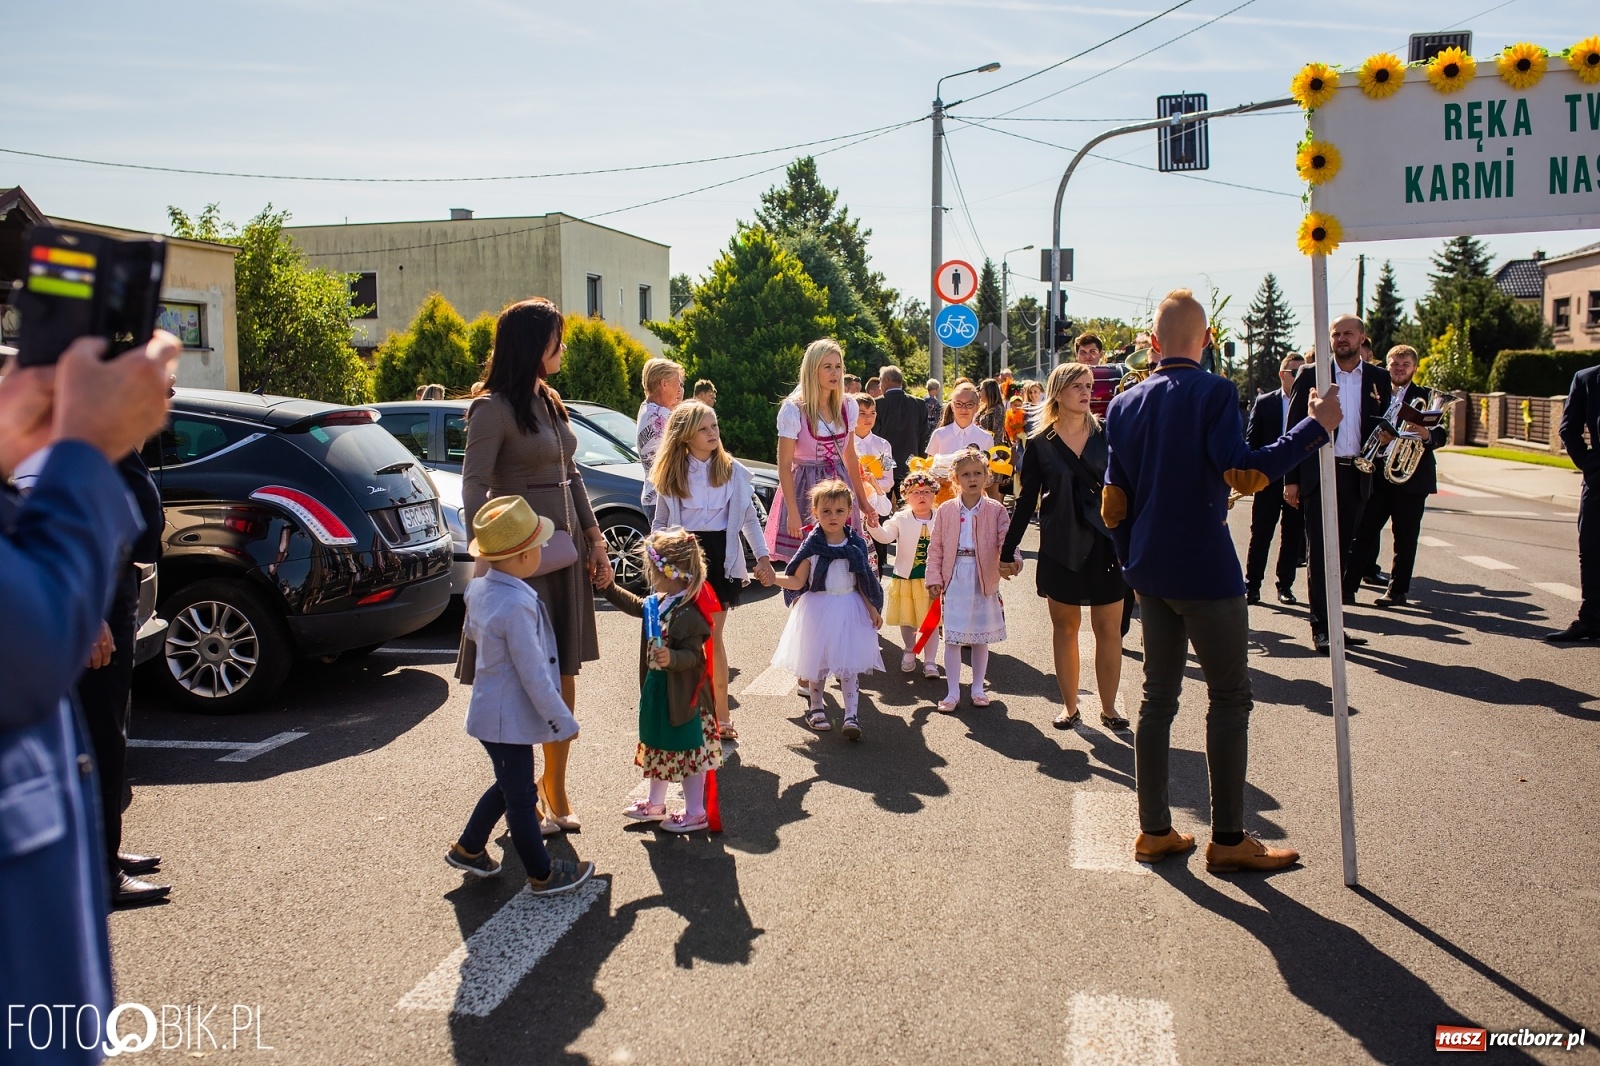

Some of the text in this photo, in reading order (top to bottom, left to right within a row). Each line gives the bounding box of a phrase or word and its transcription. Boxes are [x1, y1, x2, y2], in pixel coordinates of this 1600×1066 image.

[1444, 98, 1532, 153] RĘKA
[1549, 153, 1600, 195] NA
[404, 508, 422, 527] SRC
